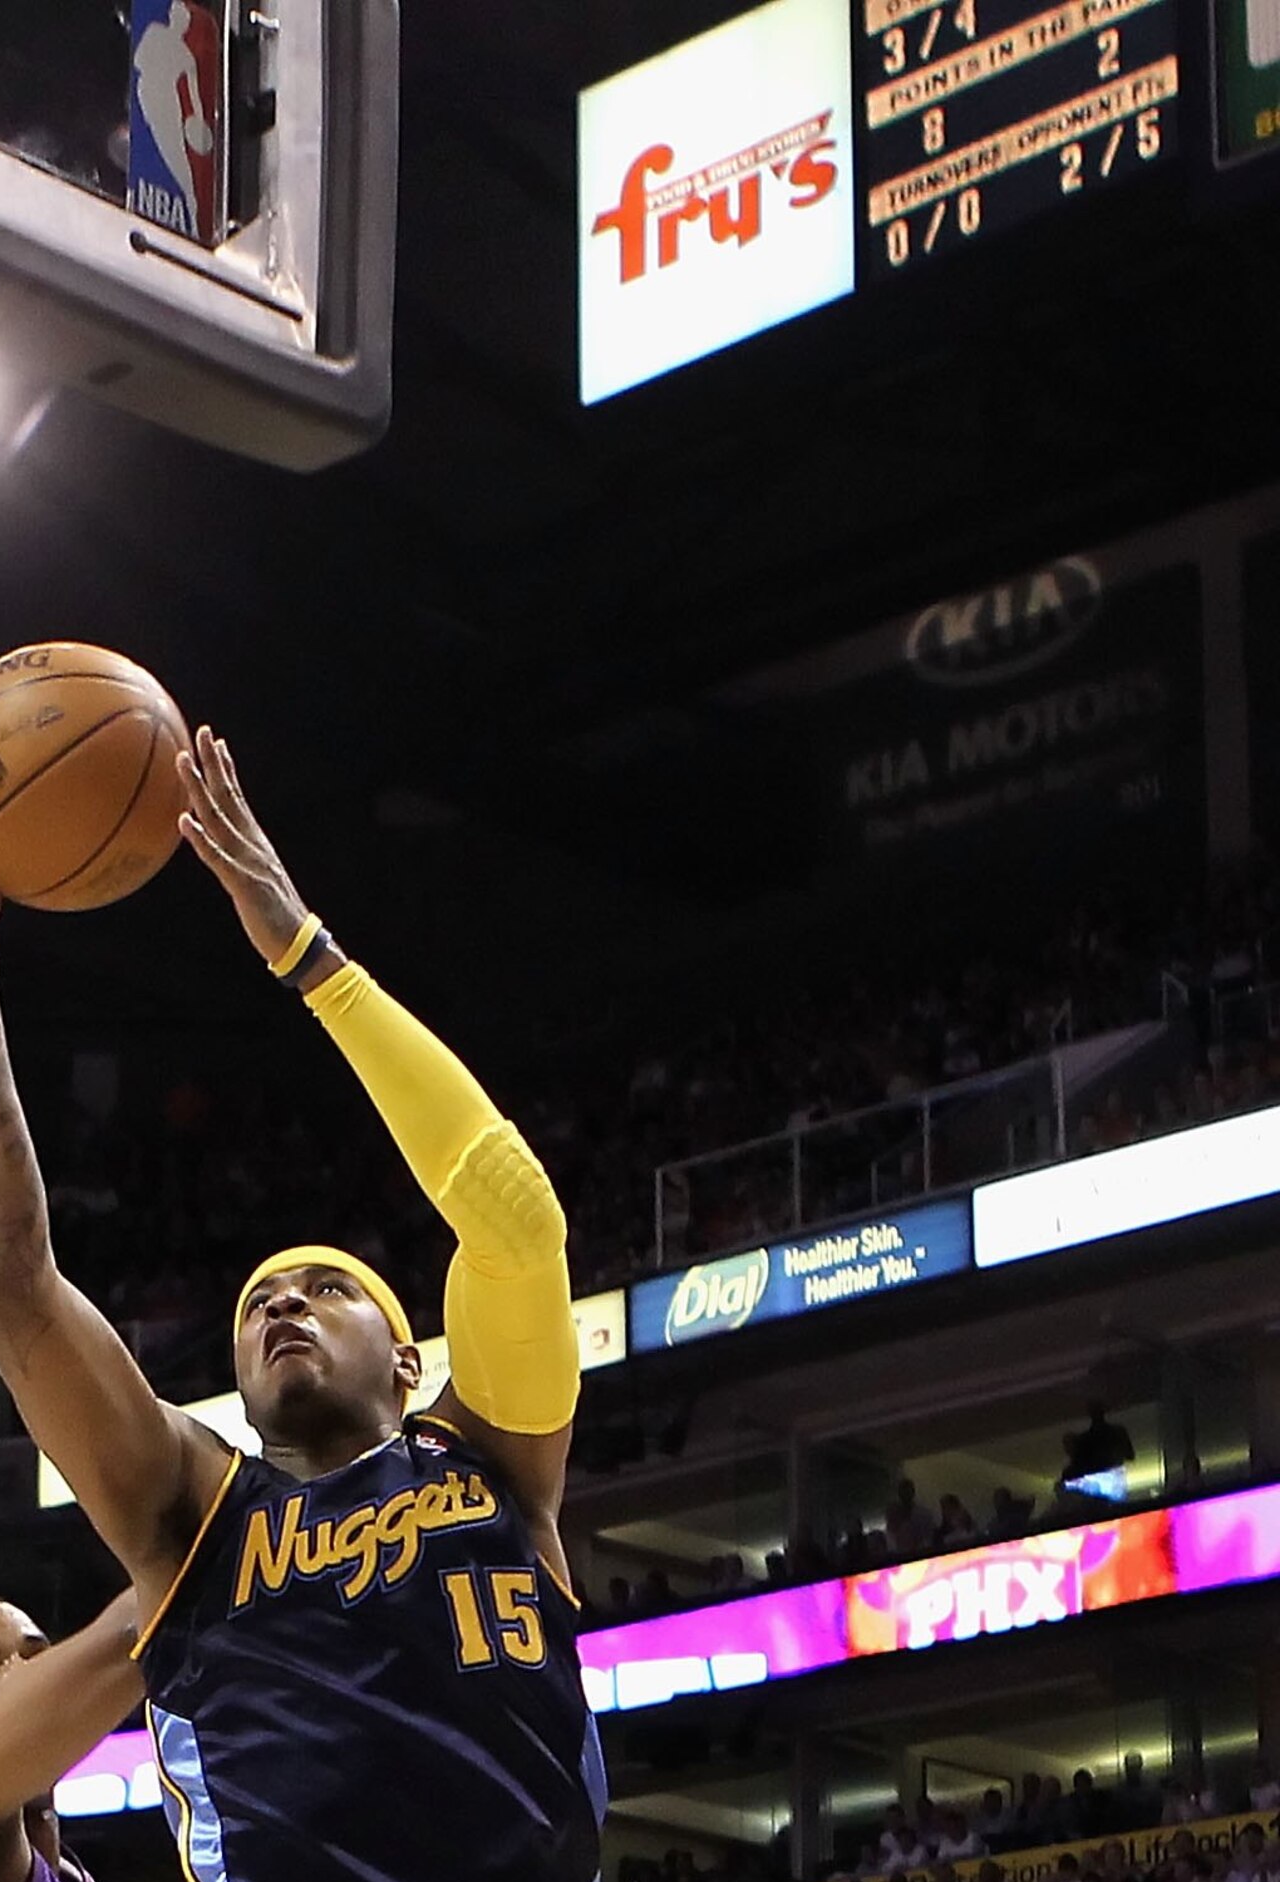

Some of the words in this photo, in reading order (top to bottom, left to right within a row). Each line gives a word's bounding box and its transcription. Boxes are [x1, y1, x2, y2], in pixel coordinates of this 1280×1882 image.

[889, 57, 980, 111] POINTS
[988, 38, 1014, 65] IN
[1027, 16, 1066, 49] THE
[1097, 27, 1121, 79] 2
[888, 142, 1003, 208] TURNOVERS
[1017, 97, 1123, 152] OPPONENT
[922, 106, 946, 155] 8
[139, 178, 190, 235] NBA
[940, 571, 1064, 664] KIA
[846, 738, 929, 810] KIA
[784, 1236, 859, 1277] Healthier
[860, 1223, 904, 1258] Skin.
[804, 1264, 880, 1306] Healthier
[674, 1264, 760, 1327] Dial
[230, 1470, 499, 1612] Nuggets
[441, 1567, 548, 1670] 15
[906, 1560, 1068, 1649] PHX
